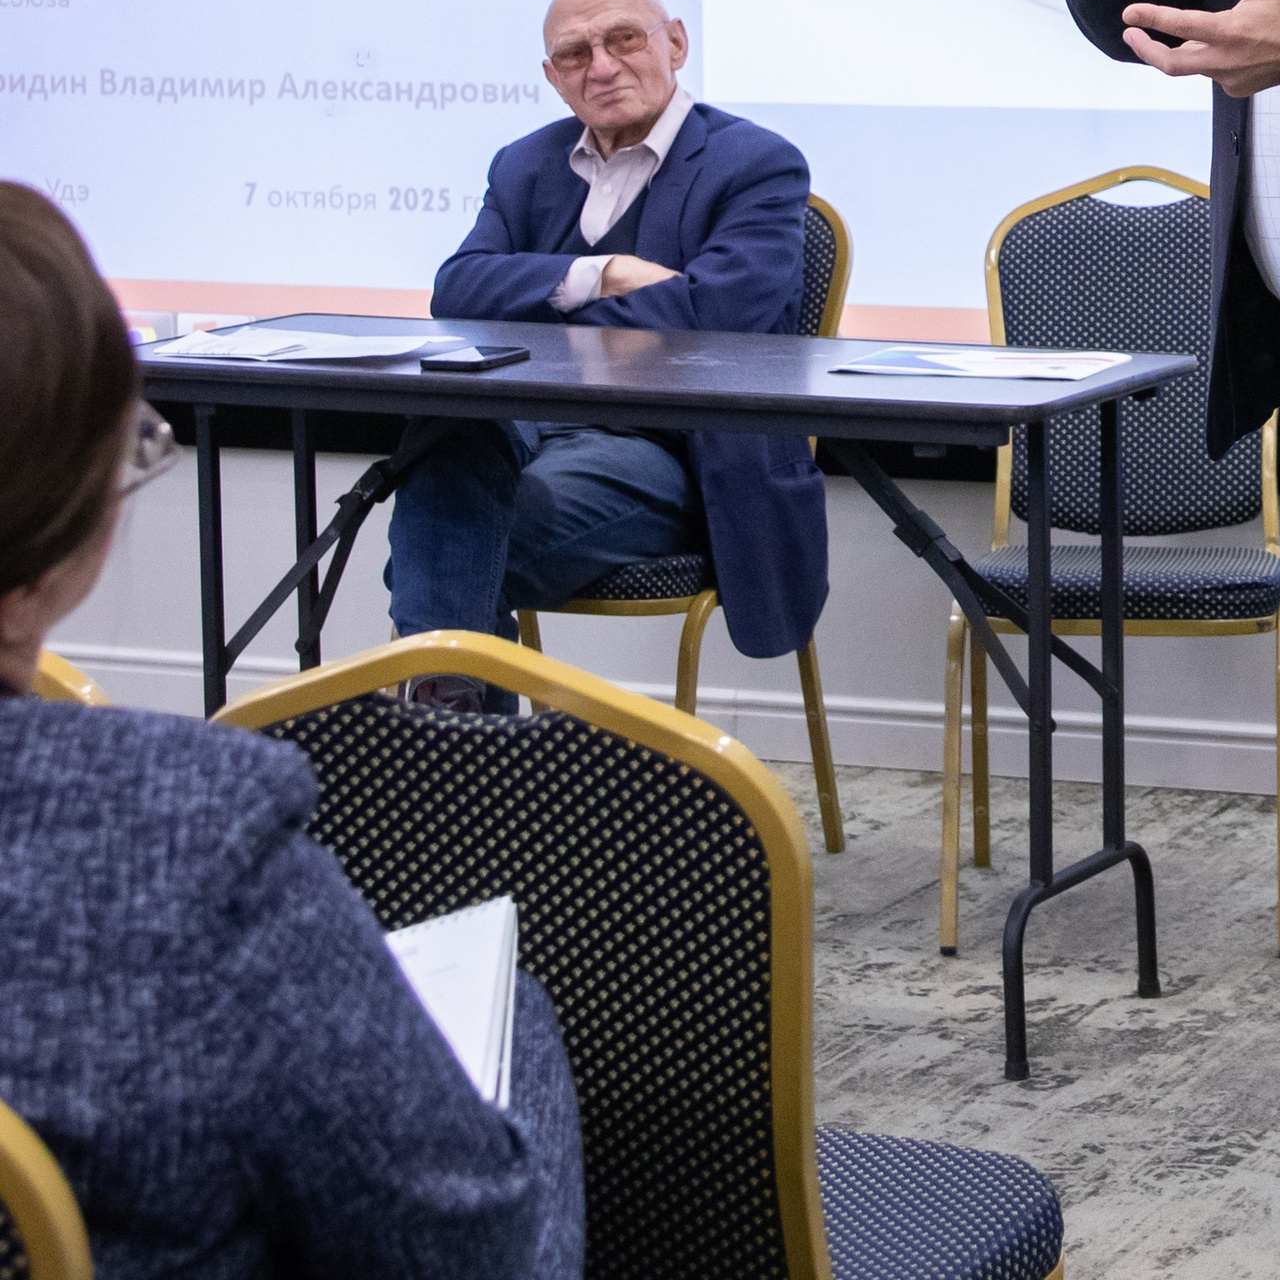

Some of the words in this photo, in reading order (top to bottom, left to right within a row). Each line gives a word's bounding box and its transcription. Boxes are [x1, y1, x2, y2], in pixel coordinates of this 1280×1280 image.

[99, 68, 267, 105] Владимир
[277, 71, 541, 109] Александрович
[243, 182, 259, 207] 7
[267, 183, 377, 212] октября
[387, 186, 452, 212] 2025
